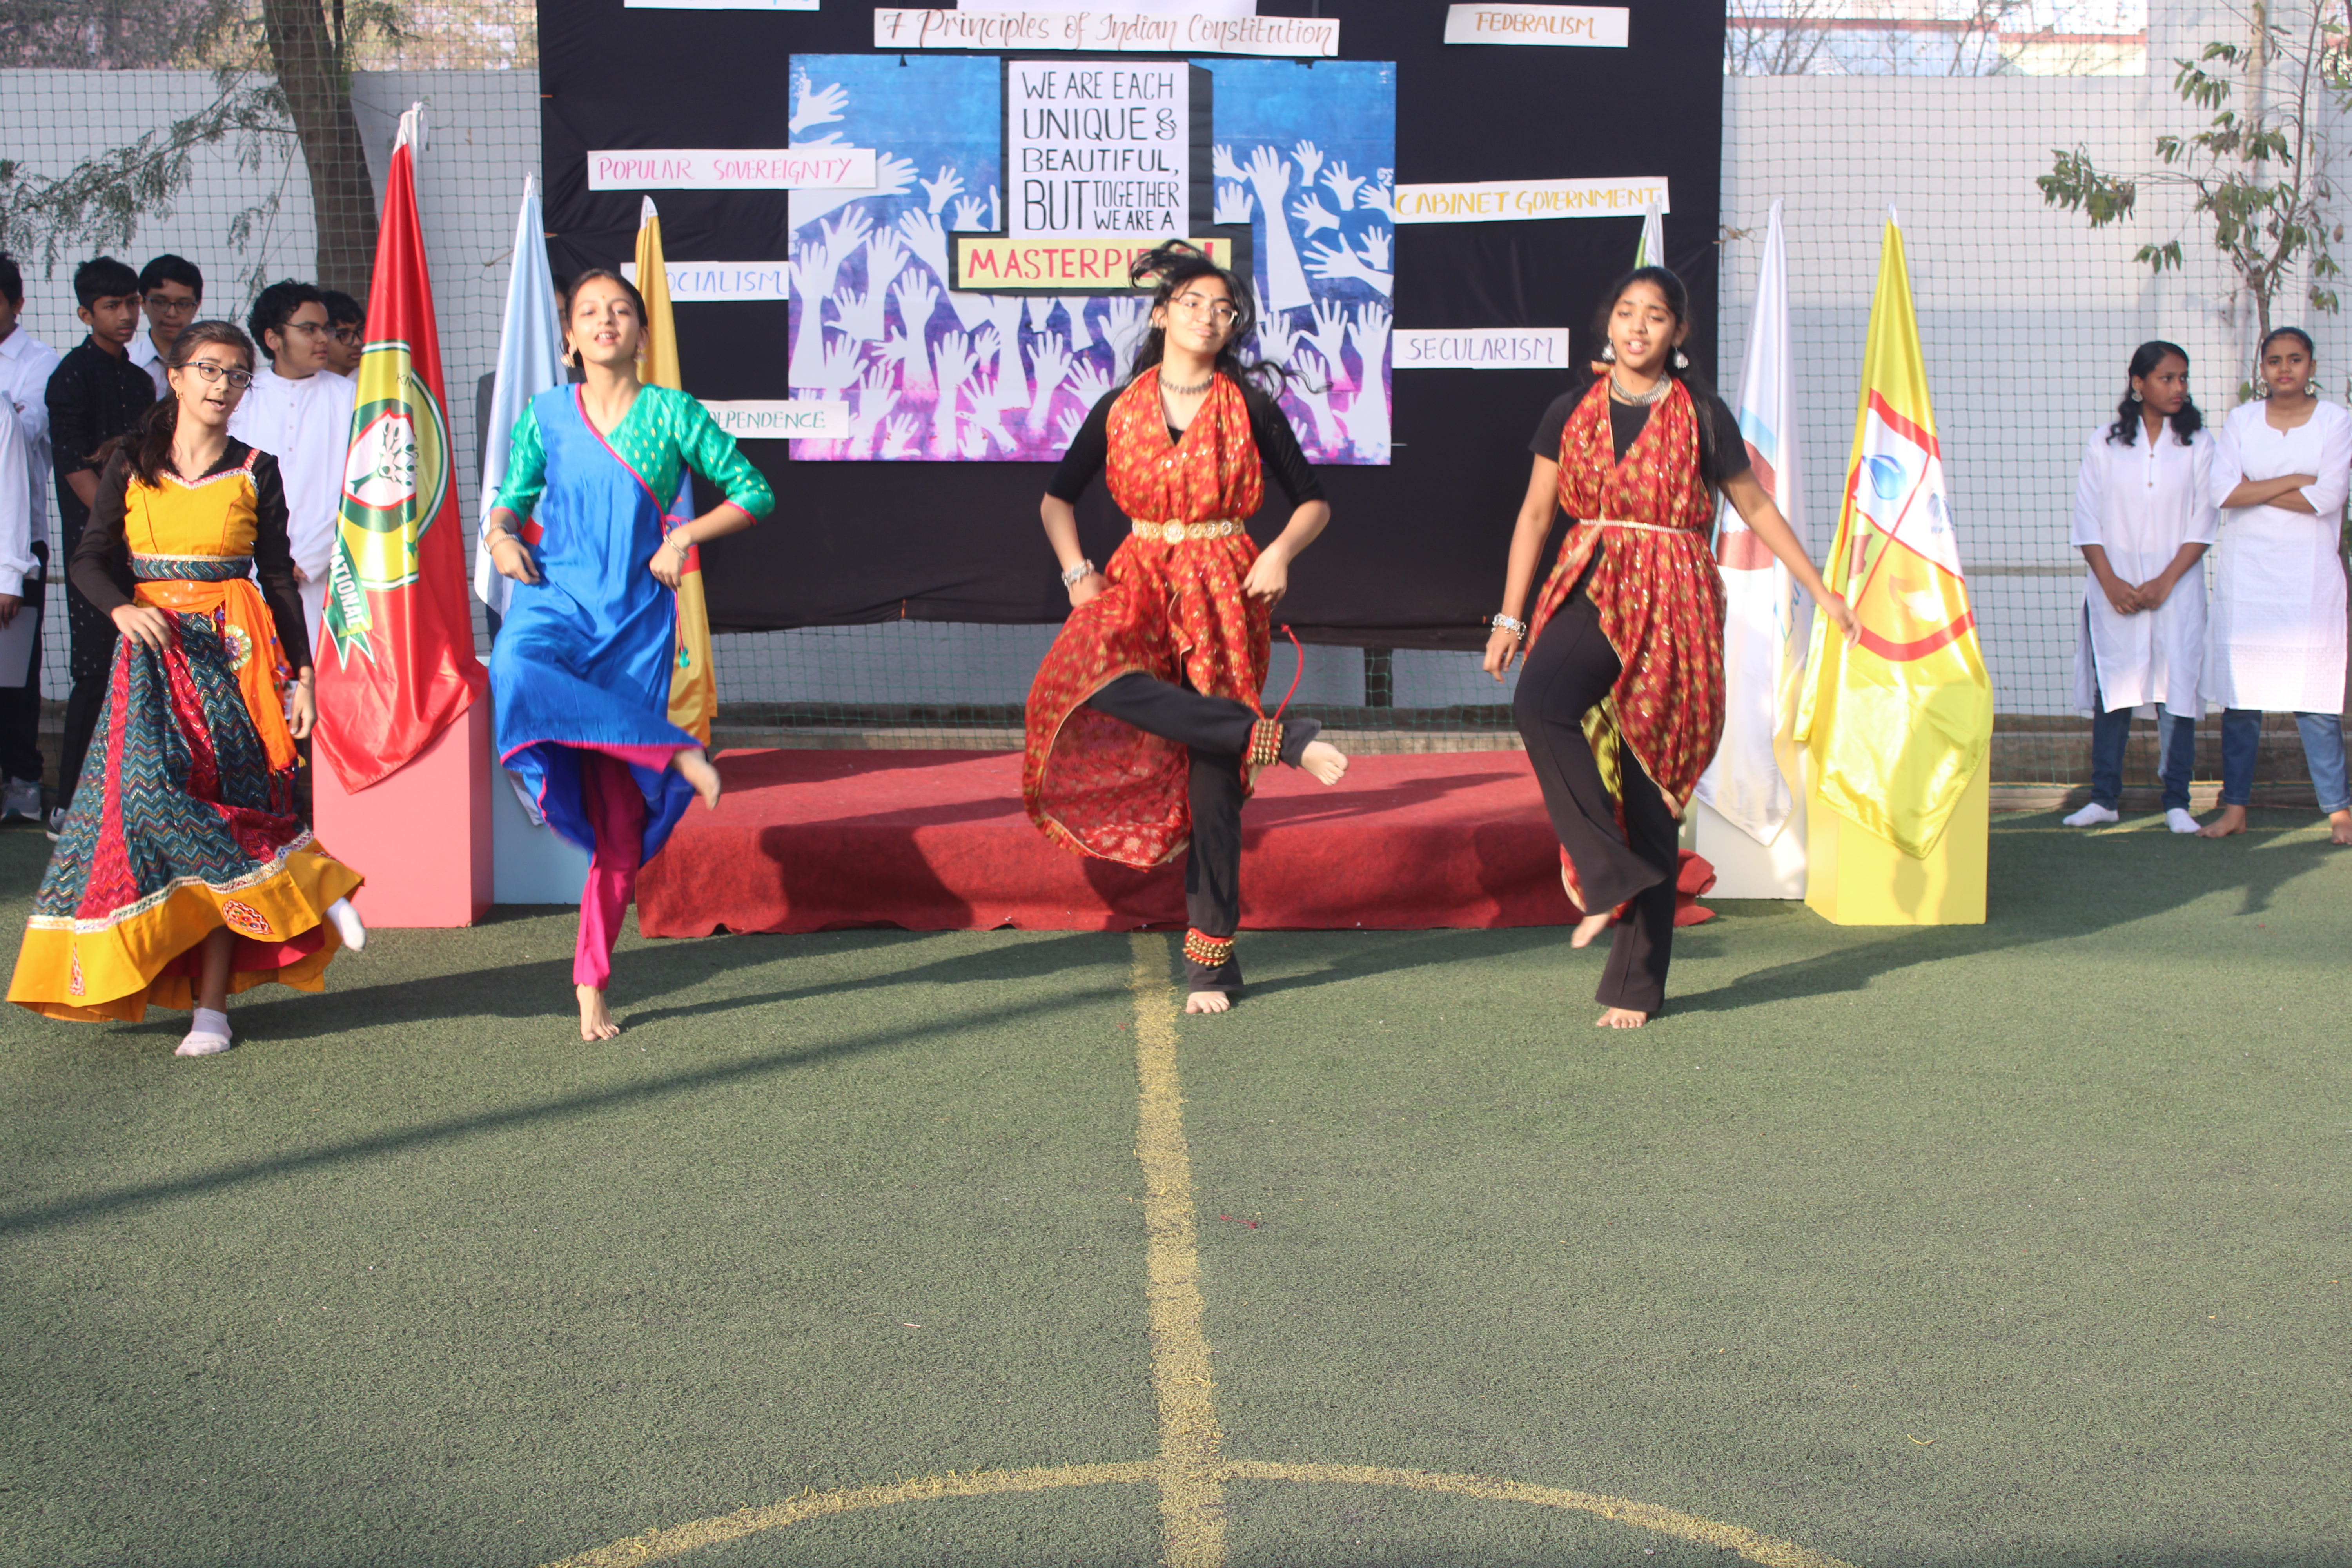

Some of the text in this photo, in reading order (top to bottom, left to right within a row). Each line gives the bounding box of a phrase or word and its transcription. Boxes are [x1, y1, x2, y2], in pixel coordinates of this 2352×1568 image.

[883, 10, 1332, 56] 7 Principles of Indian Constitution
[1474, 11, 1597, 39] FEDERALISM
[1022, 71, 1174, 100] WE ARE EACH
[1023, 107, 1177, 142] UNIQUE &
[599, 157, 852, 184] POPULAR SOVEREIGNTY
[1022, 147, 1179, 176] BEAUTIFUL,
[1024, 179, 1180, 231] BUT TOGETHER
[1396, 187, 1661, 215] CABINET GOVERNMENT
[1094, 210, 1175, 231] WE ARE A
[666, 270, 787, 295] OCIALISM
[1405, 337, 1553, 363] SECULARISM
[709, 410, 825, 430] EPENDENCE
